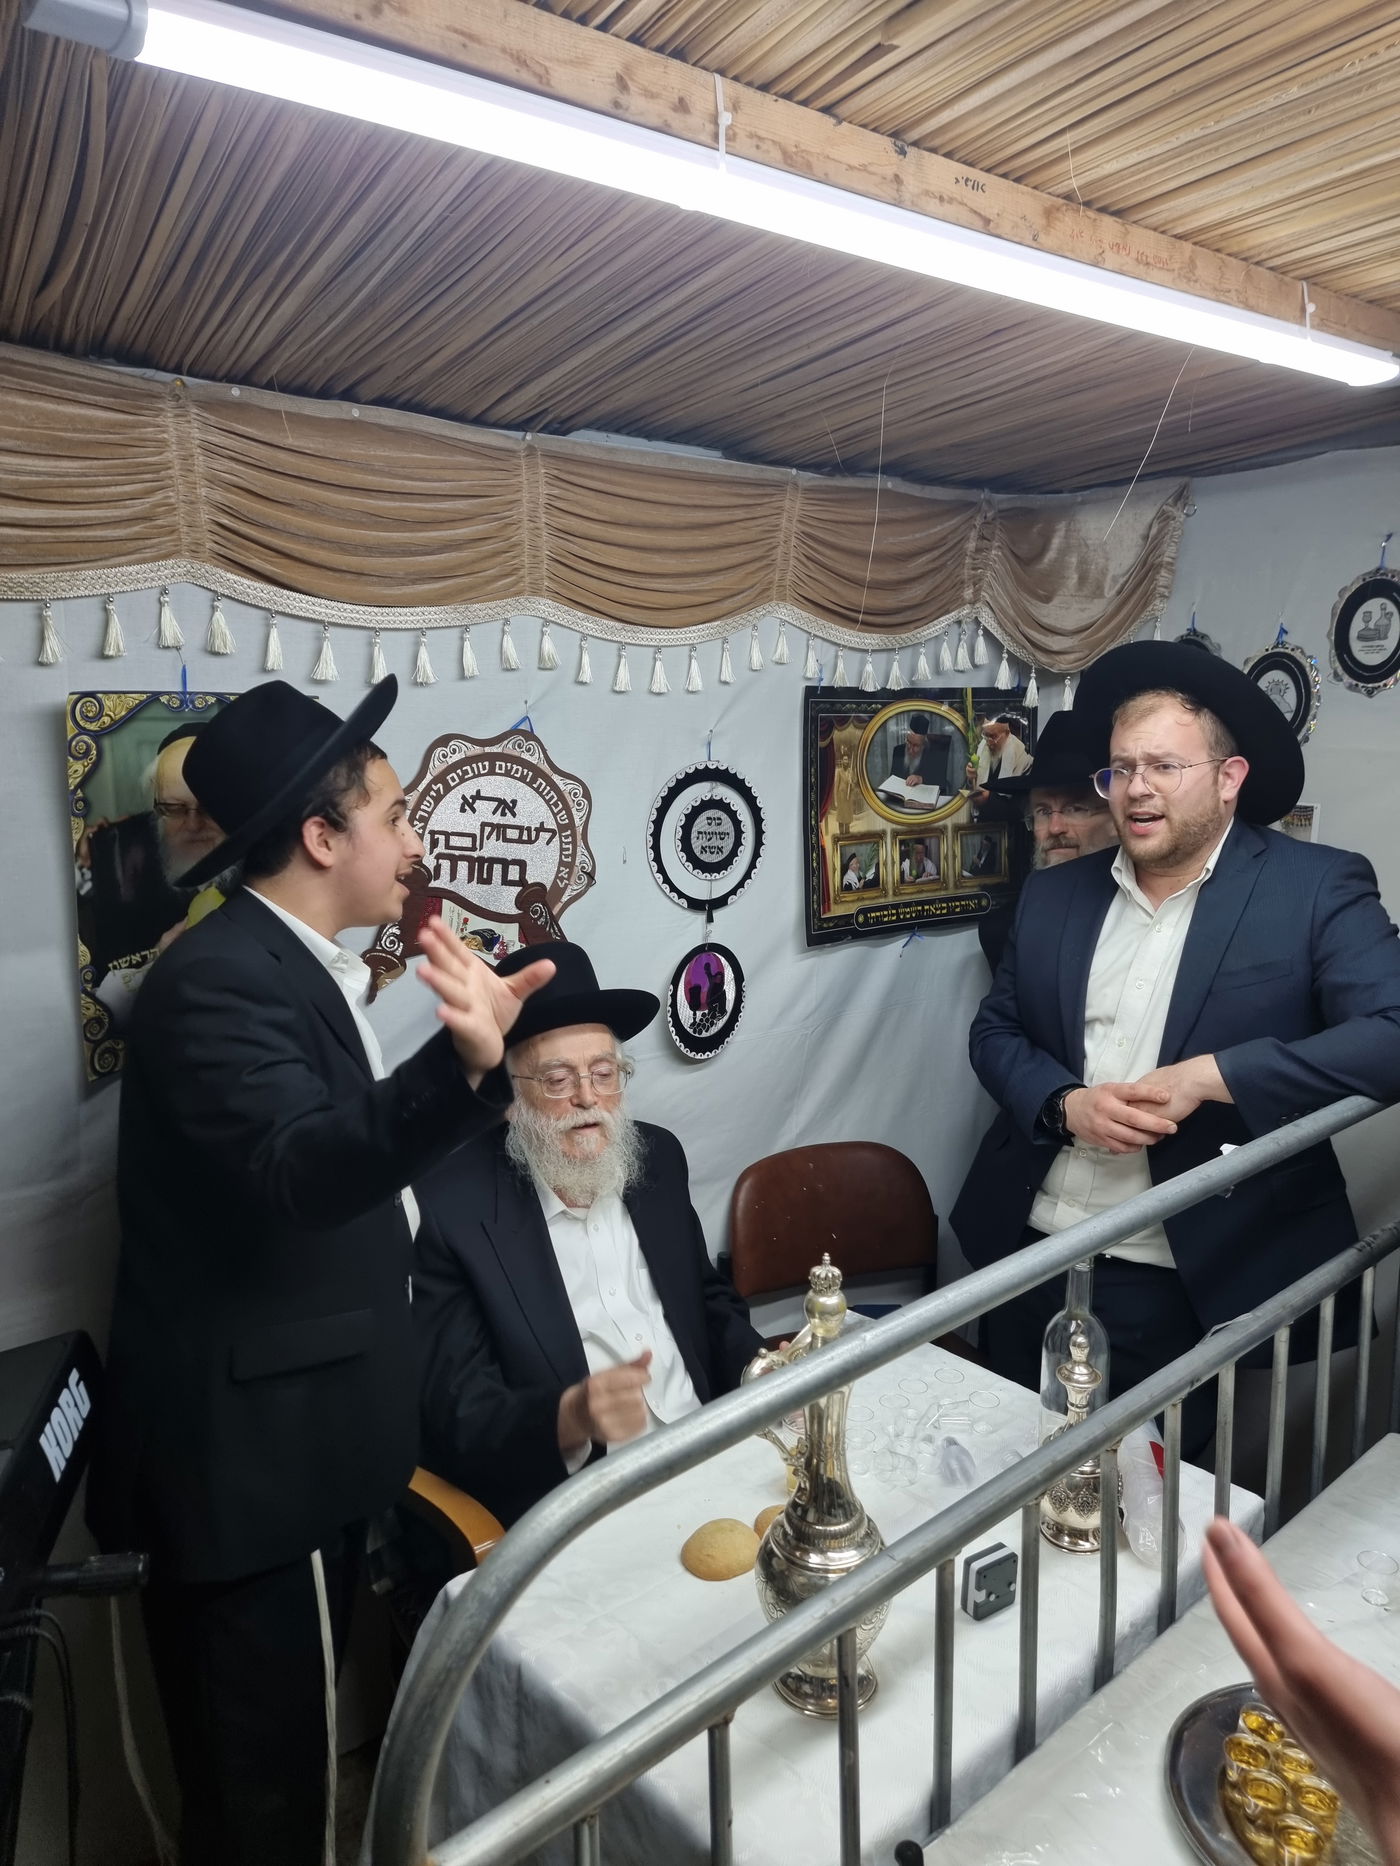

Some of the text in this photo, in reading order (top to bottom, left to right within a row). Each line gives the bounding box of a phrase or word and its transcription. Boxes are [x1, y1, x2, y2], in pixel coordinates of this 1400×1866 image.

[459, 789, 518, 819] אלא
[413, 761, 572, 888] לא נתנו שבתות וימים טובים לישרא
[479, 821, 558, 851] לעסוק
[696, 831, 730, 842] ישועות
[706, 816, 723, 827] כוס
[700, 845, 724, 855] אשא
[433, 852, 529, 888] בתורה
[898, 902, 923, 919] השמש
[39, 1367, 91, 1483] KORG
